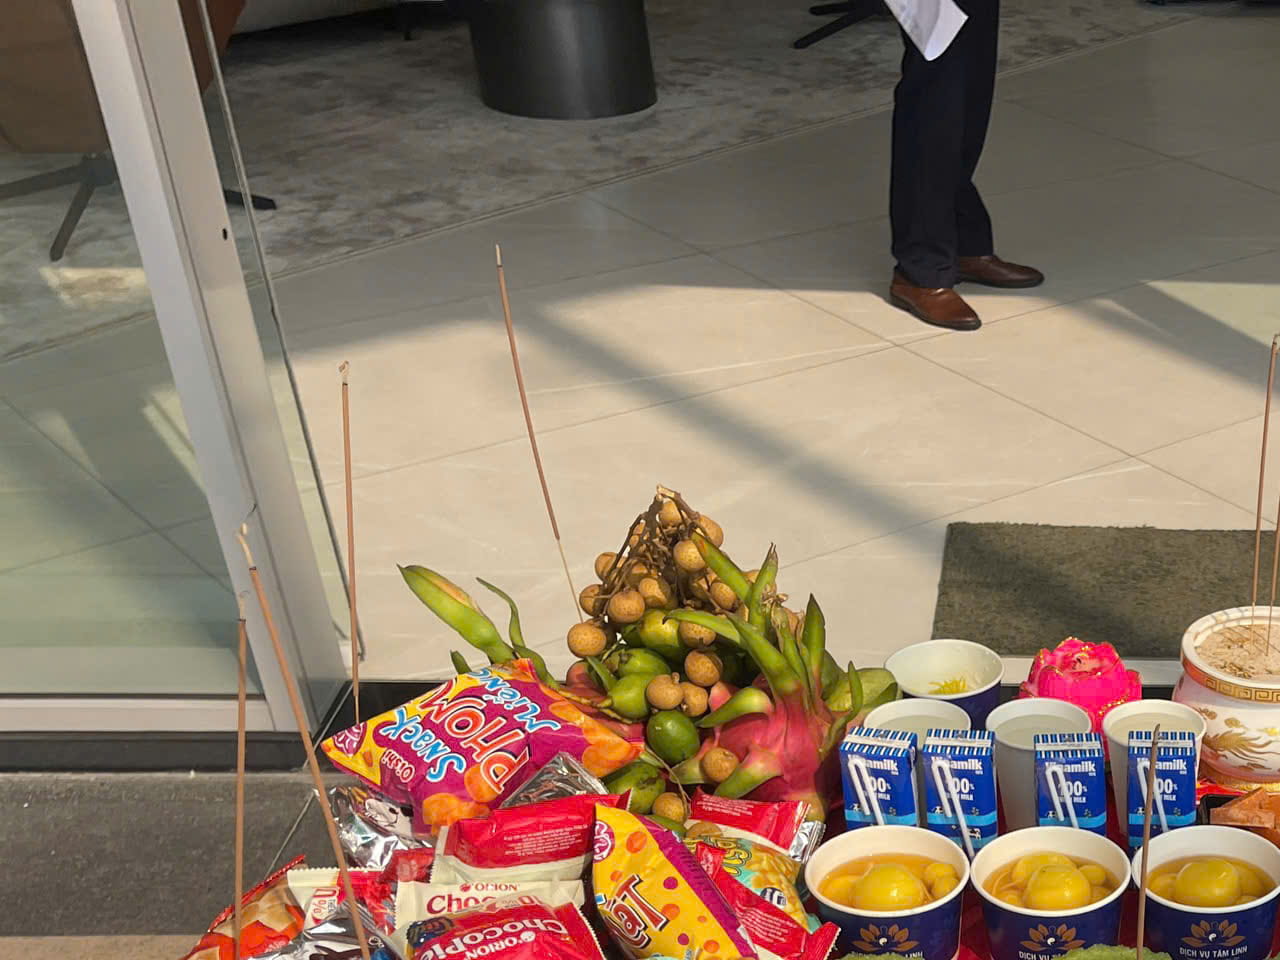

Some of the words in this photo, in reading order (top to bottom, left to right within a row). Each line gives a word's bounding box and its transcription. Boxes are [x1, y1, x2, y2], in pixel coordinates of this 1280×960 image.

[381, 750, 415, 783] Oishi
[848, 754, 898, 771] amilk
[931, 757, 983, 770] amilk
[1045, 761, 1096, 772] amilk
[1137, 758, 1187, 770] amilk
[1179, 946, 1198, 958] DỊCH
[1213, 948, 1230, 958] TÂM
[1231, 945, 1248, 957] LINH
